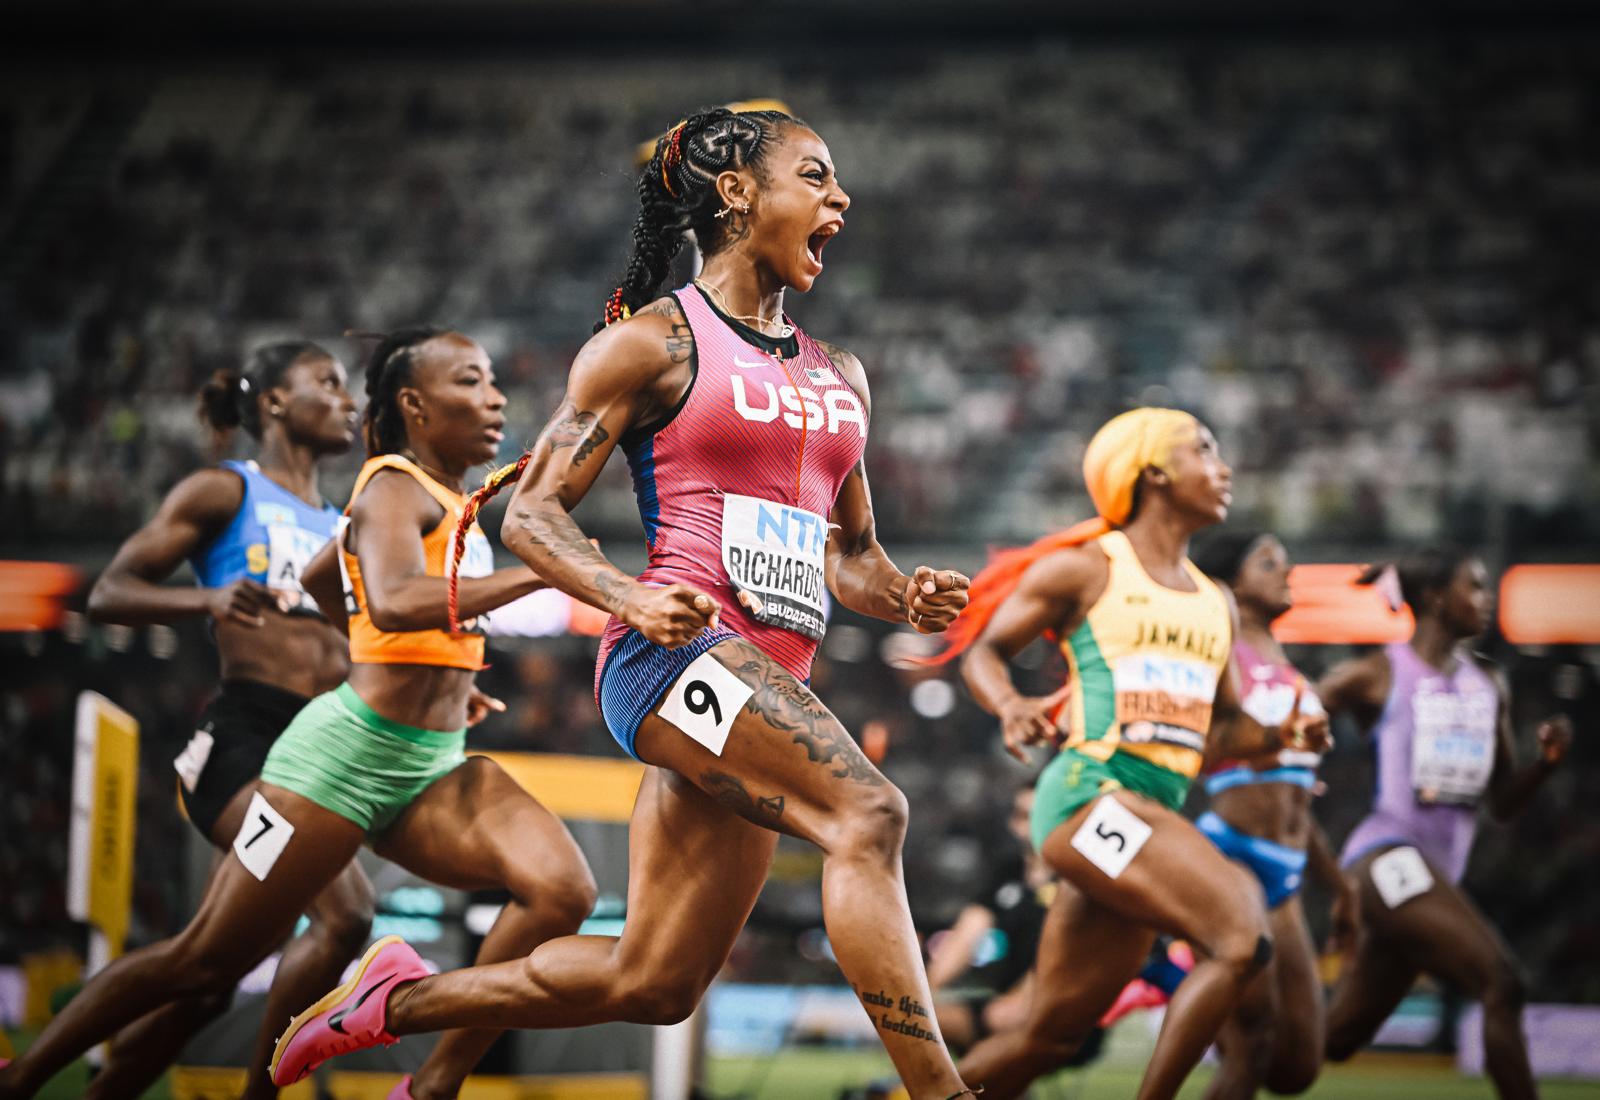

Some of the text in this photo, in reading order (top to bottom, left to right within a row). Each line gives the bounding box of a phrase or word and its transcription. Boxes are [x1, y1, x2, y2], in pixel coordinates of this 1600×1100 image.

[731, 375, 866, 438] USA
[767, 602, 820, 631] BUDAPEST
[683, 679, 723, 728] 9
[244, 812, 275, 850] 7
[1095, 821, 1126, 853] 5
